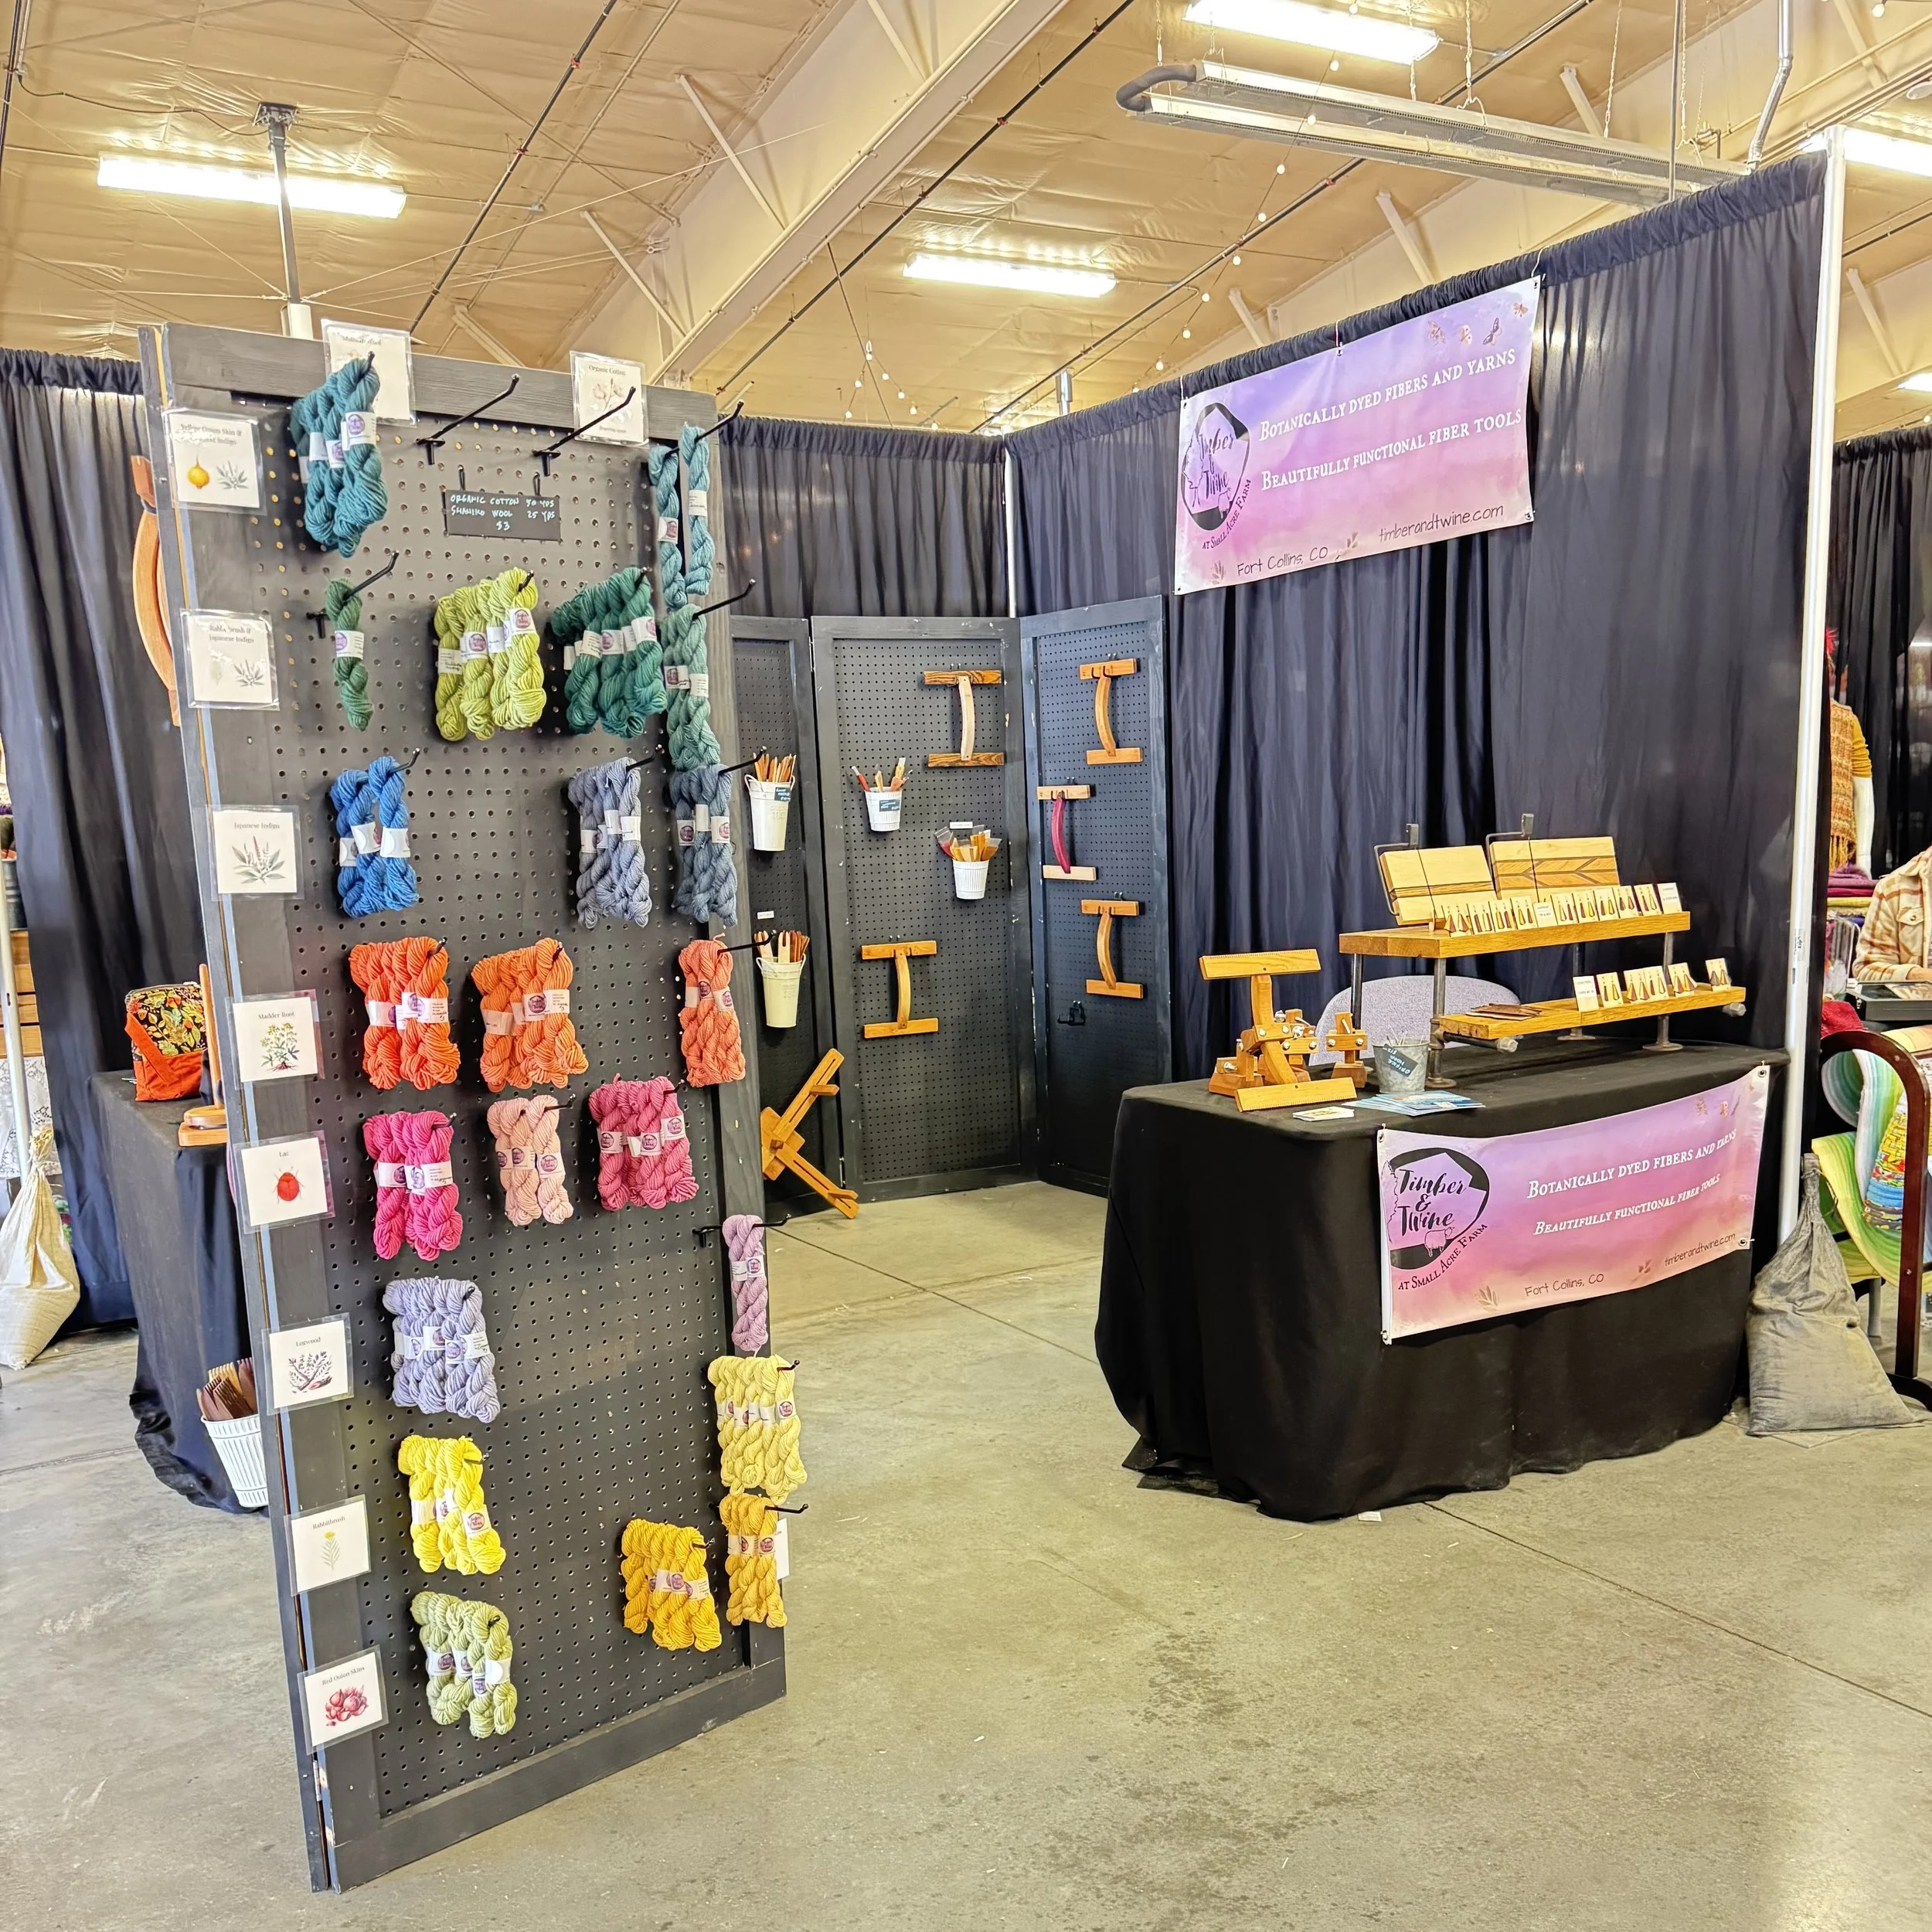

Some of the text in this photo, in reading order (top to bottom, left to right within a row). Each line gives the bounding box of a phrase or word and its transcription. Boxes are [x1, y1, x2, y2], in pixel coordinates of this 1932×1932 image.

[1259, 348, 1515, 441] BOTANICALLY DYED FIBERS AND YARNS
[1261, 408, 1522, 491] BEAUTIFULLY FUNCTIONAL FIBER TOOLS
[451, 494, 486, 504] ORGANIC
[490, 497, 519, 505] COTTON
[539, 498, 555, 508] YDS
[1236, 478, 1252, 509] FARM
[451, 505, 485, 516] SHANIKO
[526, 510, 539, 519] 25
[541, 510, 556, 522] YDS
[1378, 505, 1504, 543] timberandtwine.com
[1237, 546, 1328, 577] Fort Collins, CO
[1398, 1168, 1467, 1196] Timber
[1526, 1167, 1616, 1199] BOTANICALLY
[1617, 1159, 1650, 1179] DYED
[1653, 1148, 1694, 1169] FIBERS
[1695, 1142, 1716, 1159] AND
[1415, 1193, 1431, 1213] &
[1532, 1173, 1721, 1236] BEAUTIFULLY FUNCTIONAL FIBER TOOLS
[1396, 1206, 1454, 1236] Twine
[1398, 1223, 1488, 1291] AT SMALL ACRE FARM
[1525, 1273, 1604, 1297] Fort Collins, CO
